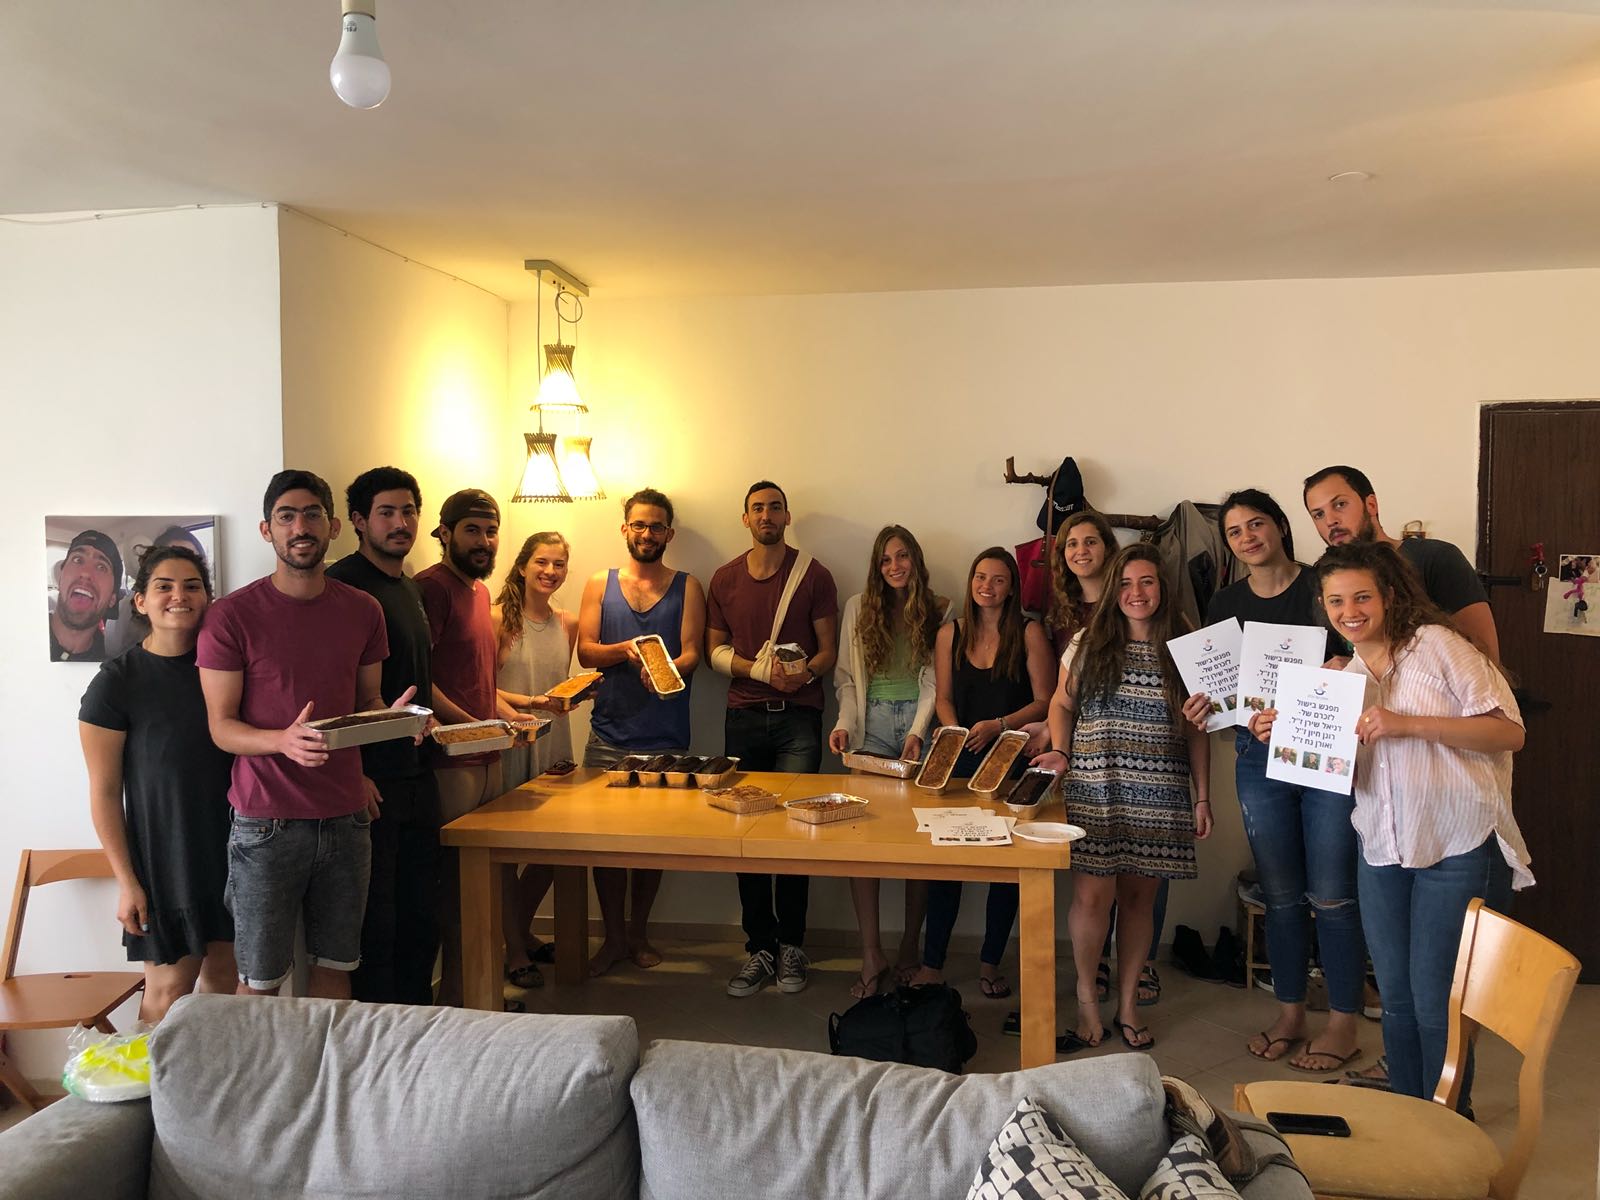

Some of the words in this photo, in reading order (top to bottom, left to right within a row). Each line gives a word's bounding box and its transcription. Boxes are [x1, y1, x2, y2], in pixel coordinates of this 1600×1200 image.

[1195, 658, 1213, 667] בישול
[1264, 654, 1282, 662] בישול
[1213, 659, 1231, 669] לזכרם
[1296, 699, 1317, 709] בישול
[1318, 703, 1339, 713] מפגש
[1313, 712, 1335, 721] לזכרם
[1304, 720, 1320, 728] שירן
[1322, 722, 1342, 732] דניאל
[1308, 730, 1321, 738] חיון
[1322, 732, 1335, 740] רונן
[1304, 738, 1314, 746] נח
[1315, 740, 1332, 750] ואורן
